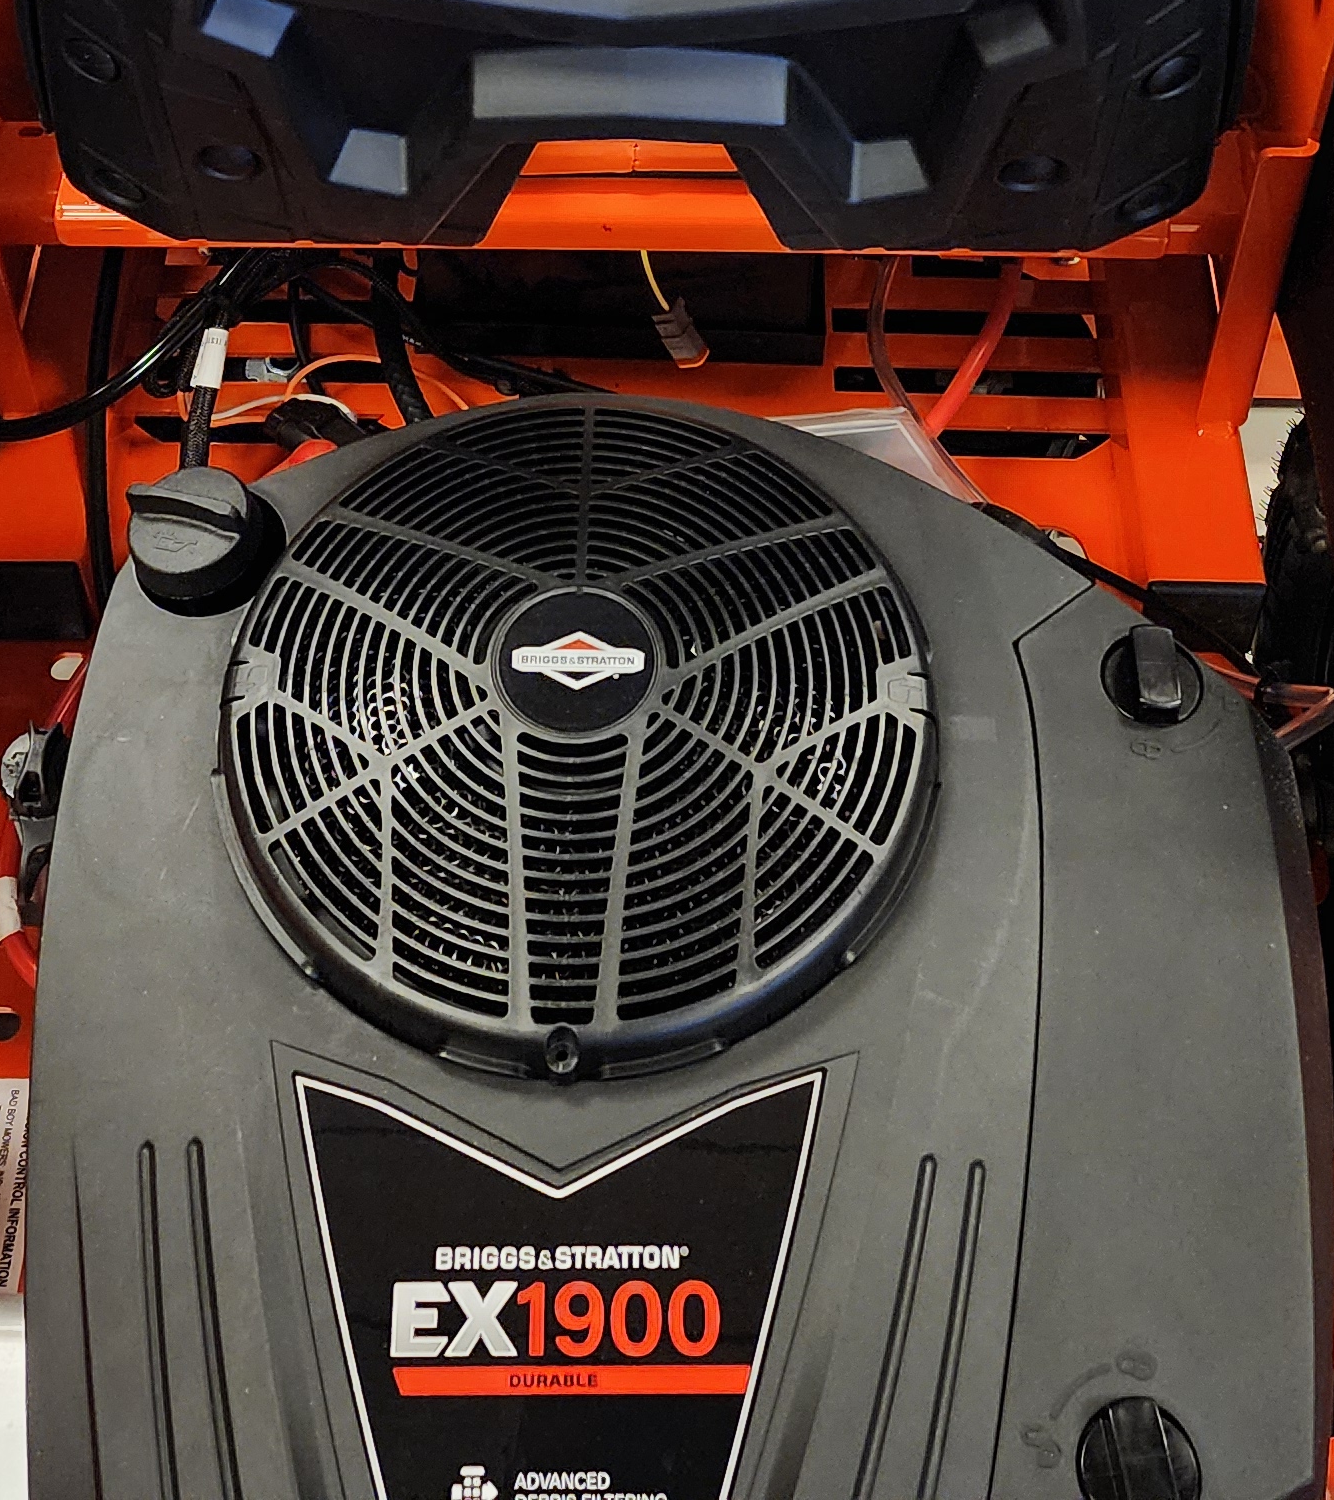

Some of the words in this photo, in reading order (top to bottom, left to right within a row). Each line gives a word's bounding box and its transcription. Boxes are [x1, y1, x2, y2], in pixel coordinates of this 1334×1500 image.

[9, 1090, 20, 1107] BAD
[5, 1109, 16, 1126] BOY
[9, 1151, 27, 1206] CONTROL
[434, 1244, 682, 1271] BRIGGS&STRATTON
[389, 1279, 722, 1359] EX1900
[508, 1372, 600, 1390] DURABLE
[513, 1471, 612, 1491] ADVANCED
